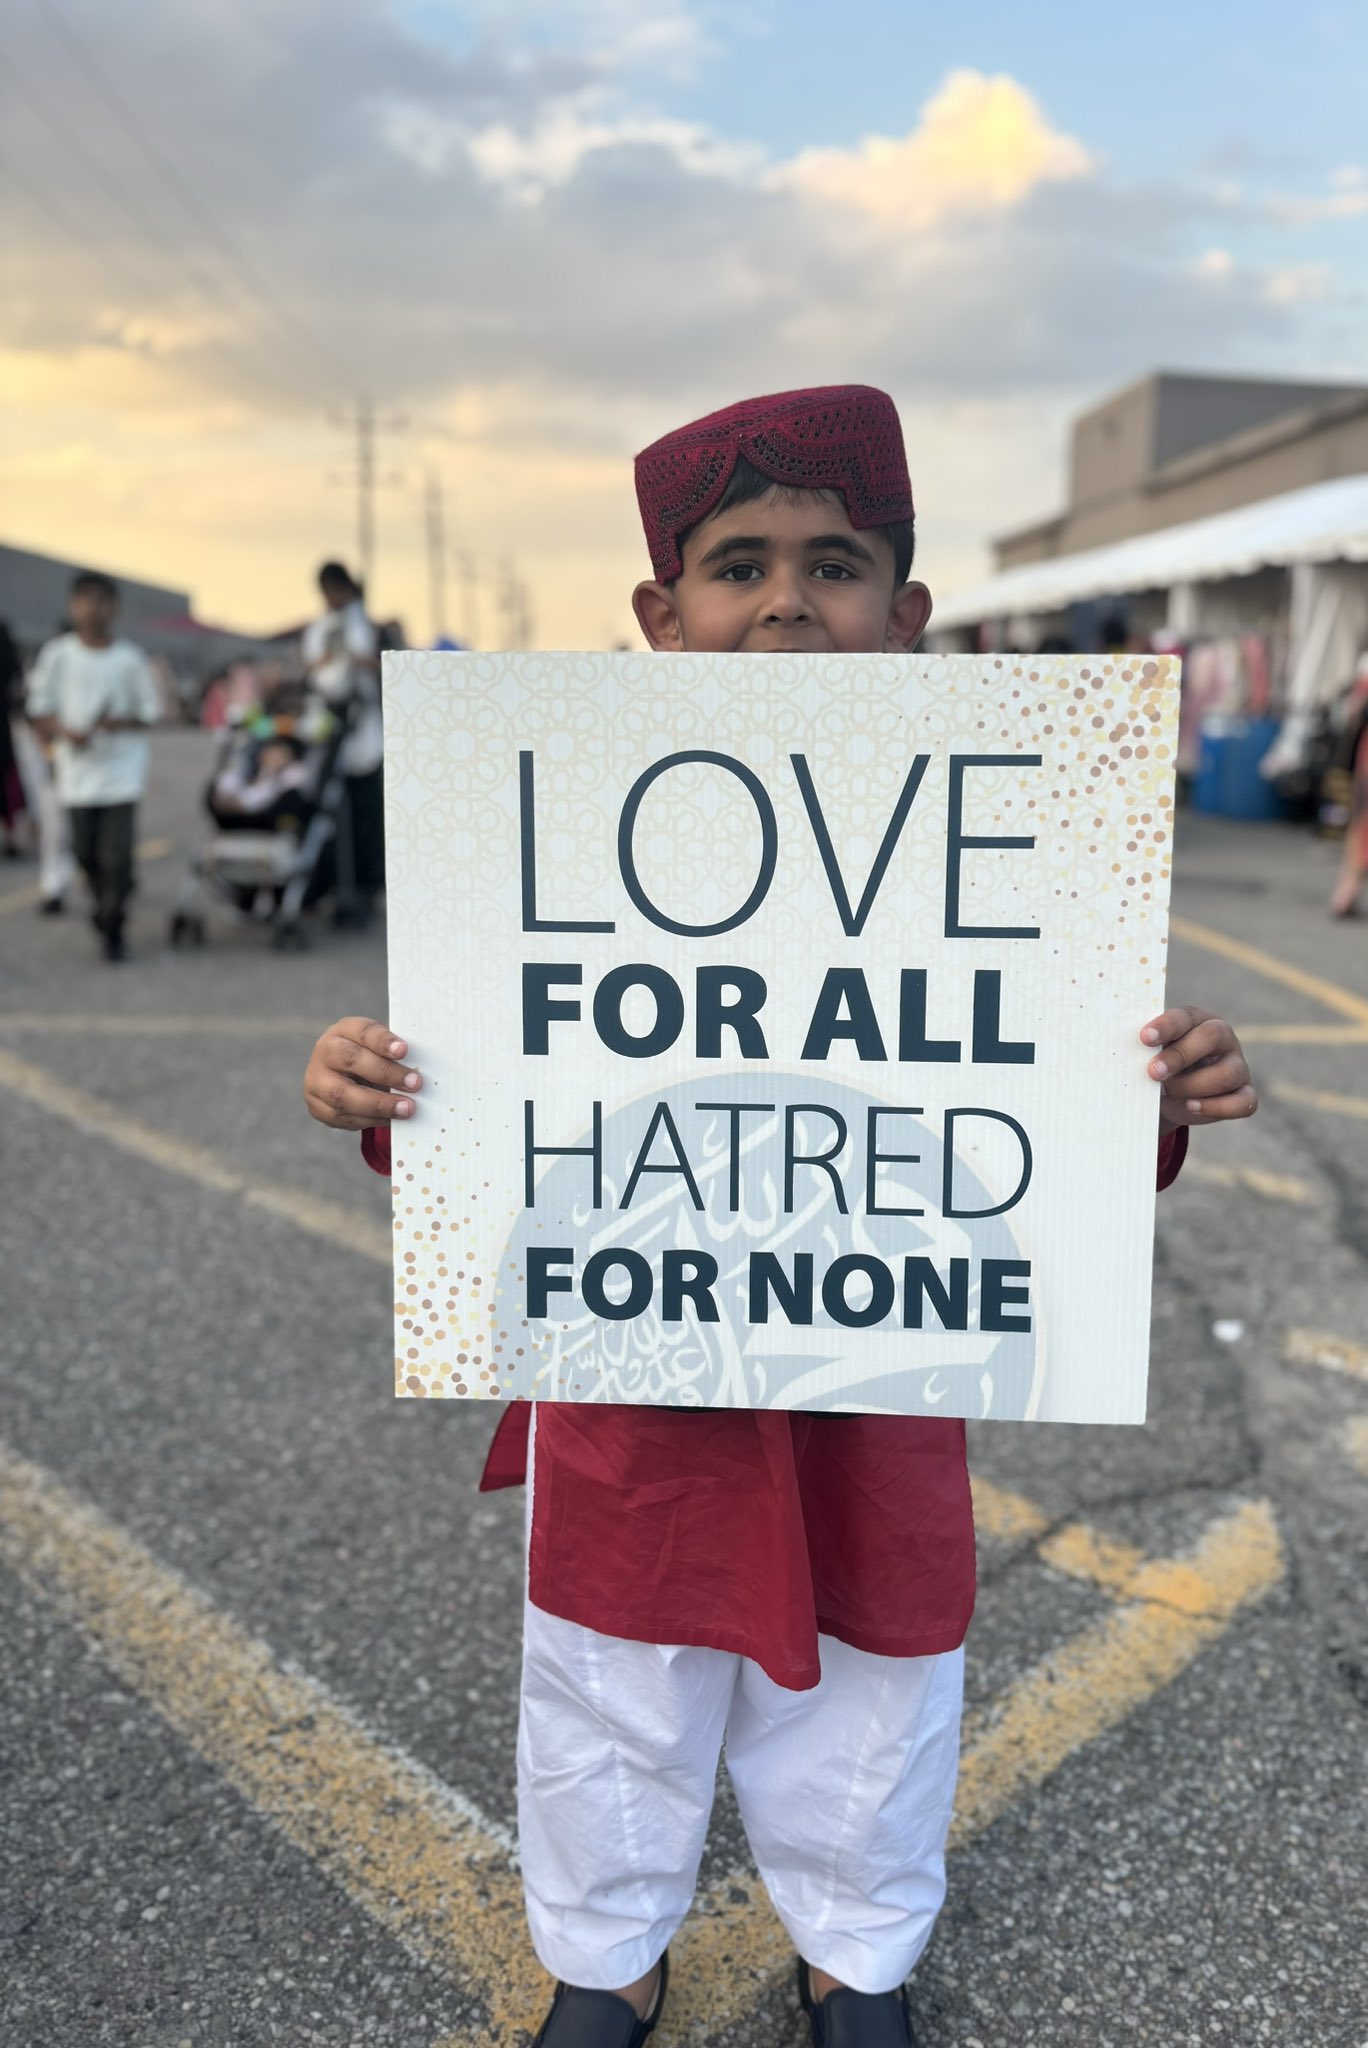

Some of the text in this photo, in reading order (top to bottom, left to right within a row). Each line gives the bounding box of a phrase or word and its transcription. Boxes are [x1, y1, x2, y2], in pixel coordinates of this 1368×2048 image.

[519, 750, 1043, 939] LOVE
[521, 963, 1036, 1065] FOR ALL
[524, 1099, 1033, 1219] HATRED
[526, 1246, 1032, 1334] FOR NONE
